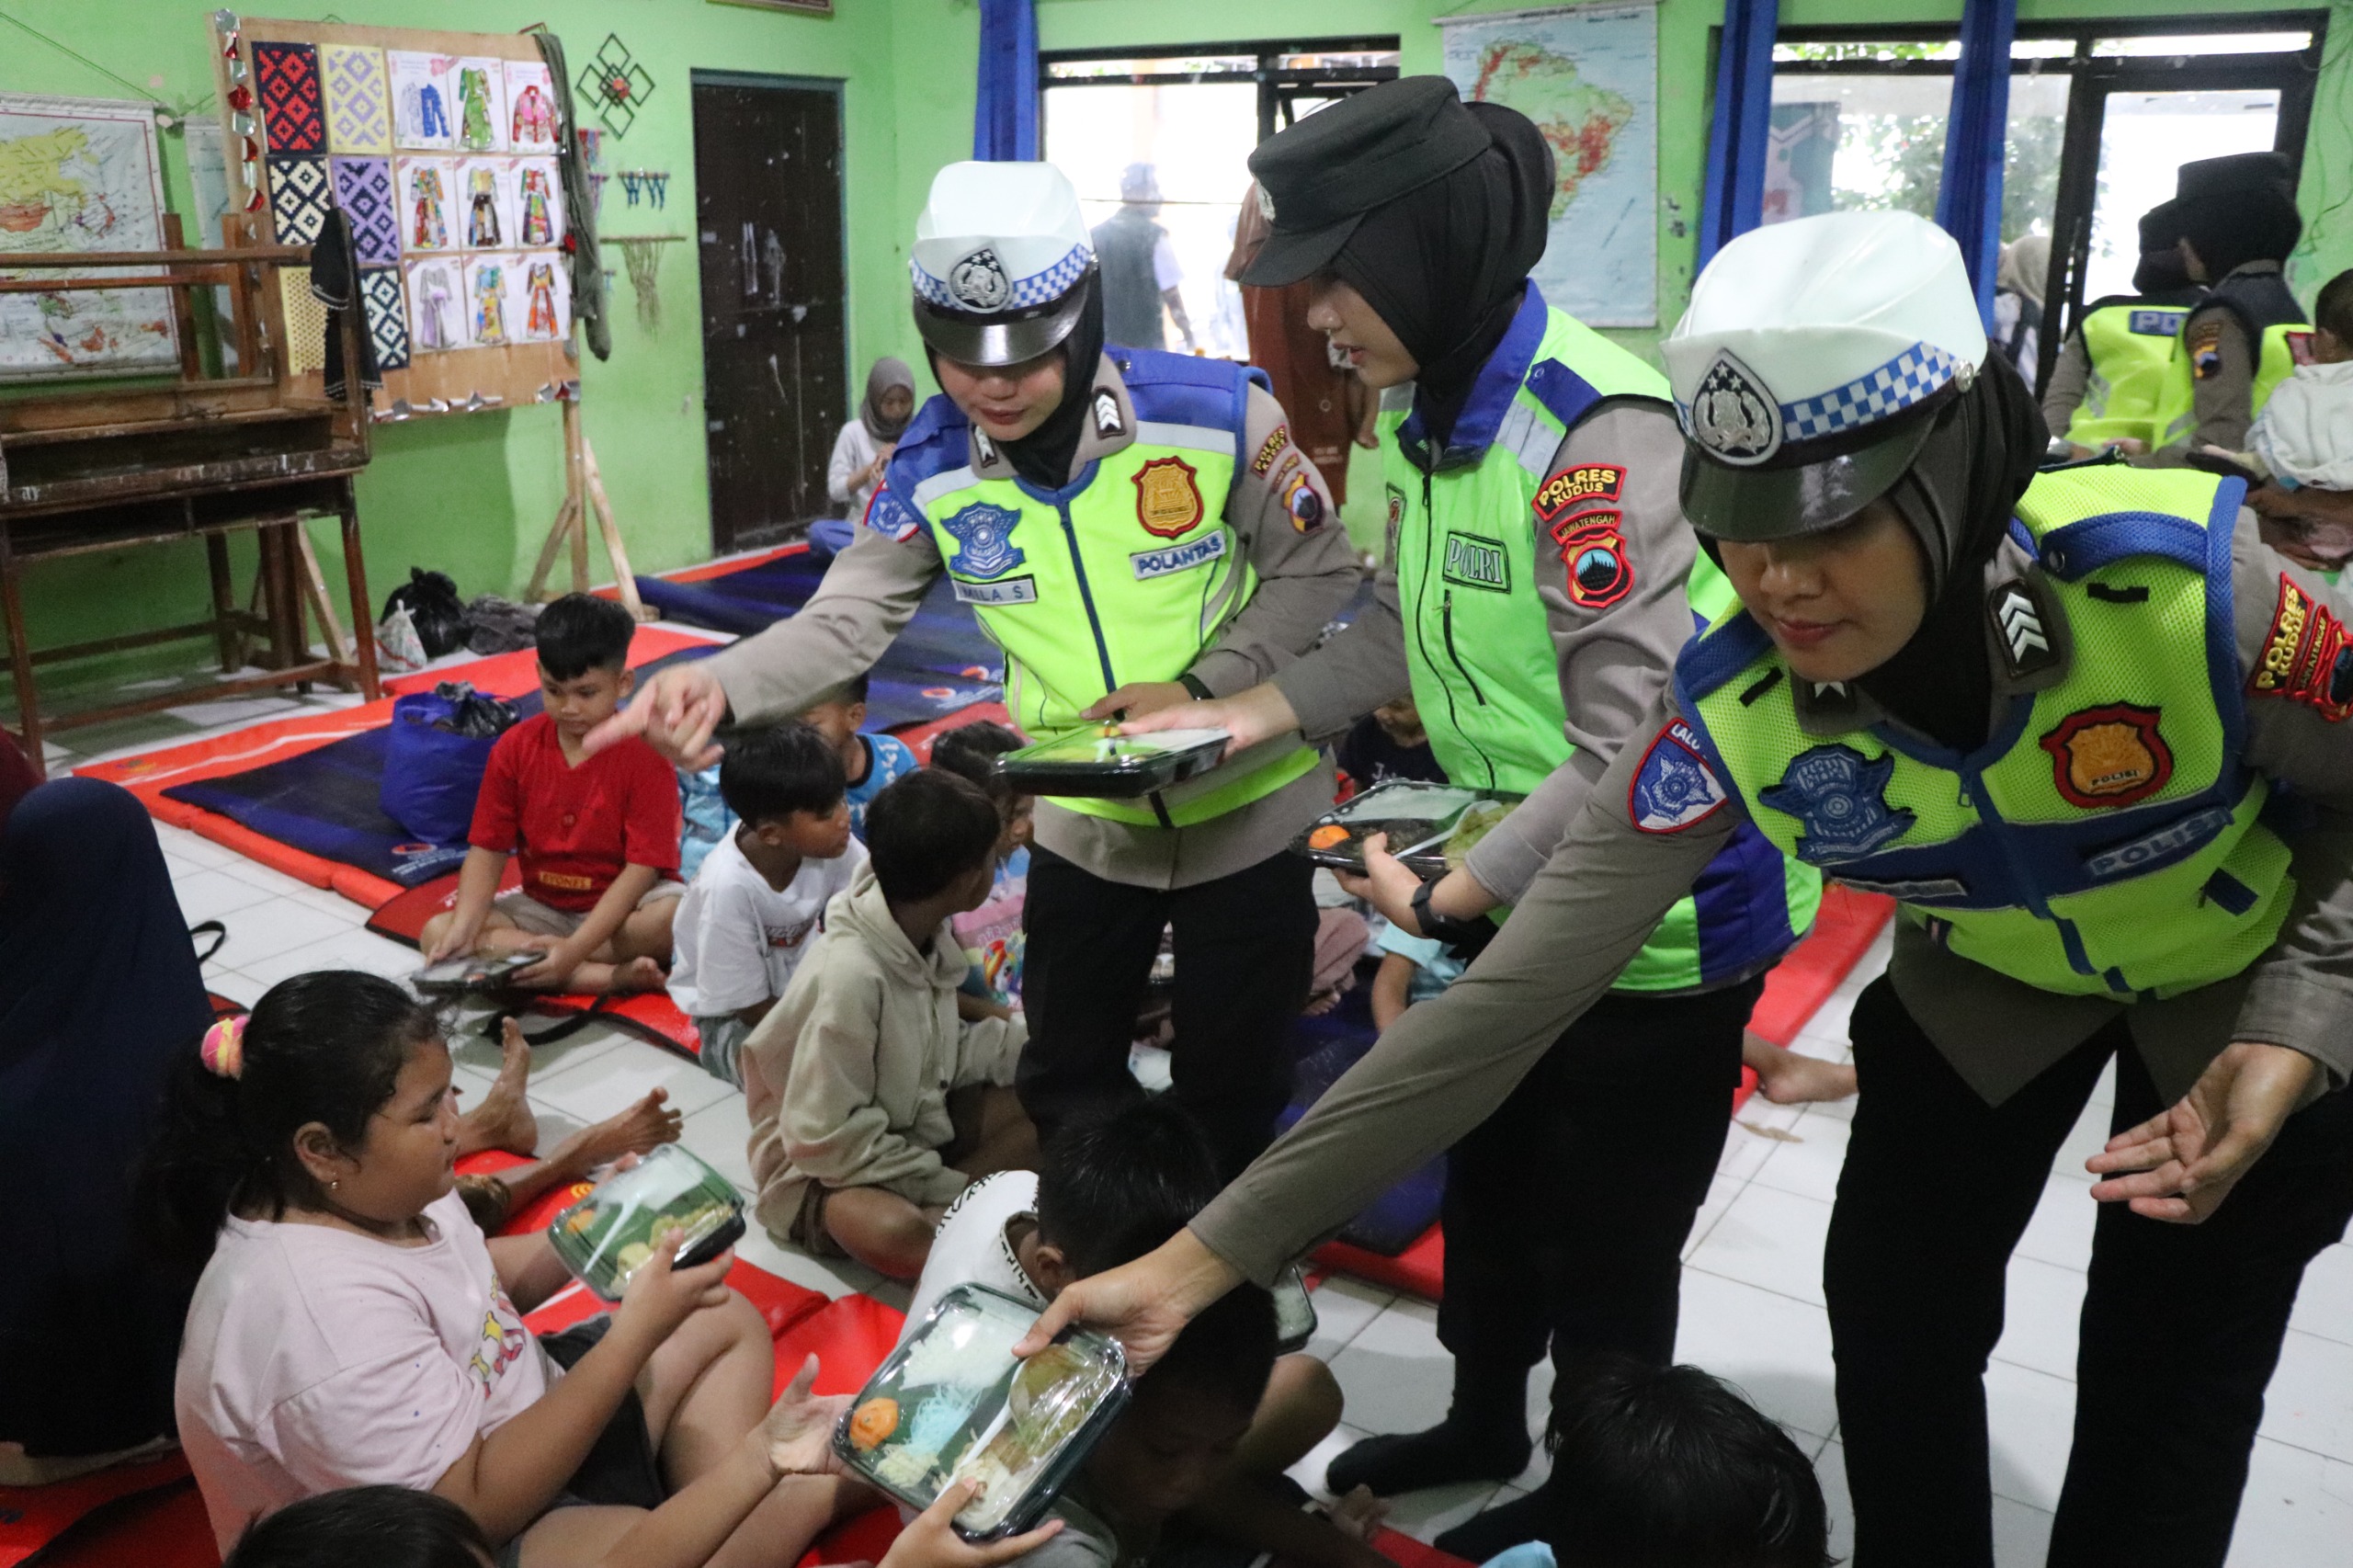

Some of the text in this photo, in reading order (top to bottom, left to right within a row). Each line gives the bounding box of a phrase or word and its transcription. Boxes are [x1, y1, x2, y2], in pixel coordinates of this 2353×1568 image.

[1538, 469, 1617, 506] POLRES
[1552, 482, 1605, 506] KUDUS
[1137, 535, 1223, 574] POLANTAS
[1447, 539, 1504, 585] POLRI
[2256, 584, 2299, 689] POLRES
[2277, 606, 2306, 676] KUDUS
[2090, 769, 2139, 786] POLISI
[2093, 811, 2224, 874] POLISI
